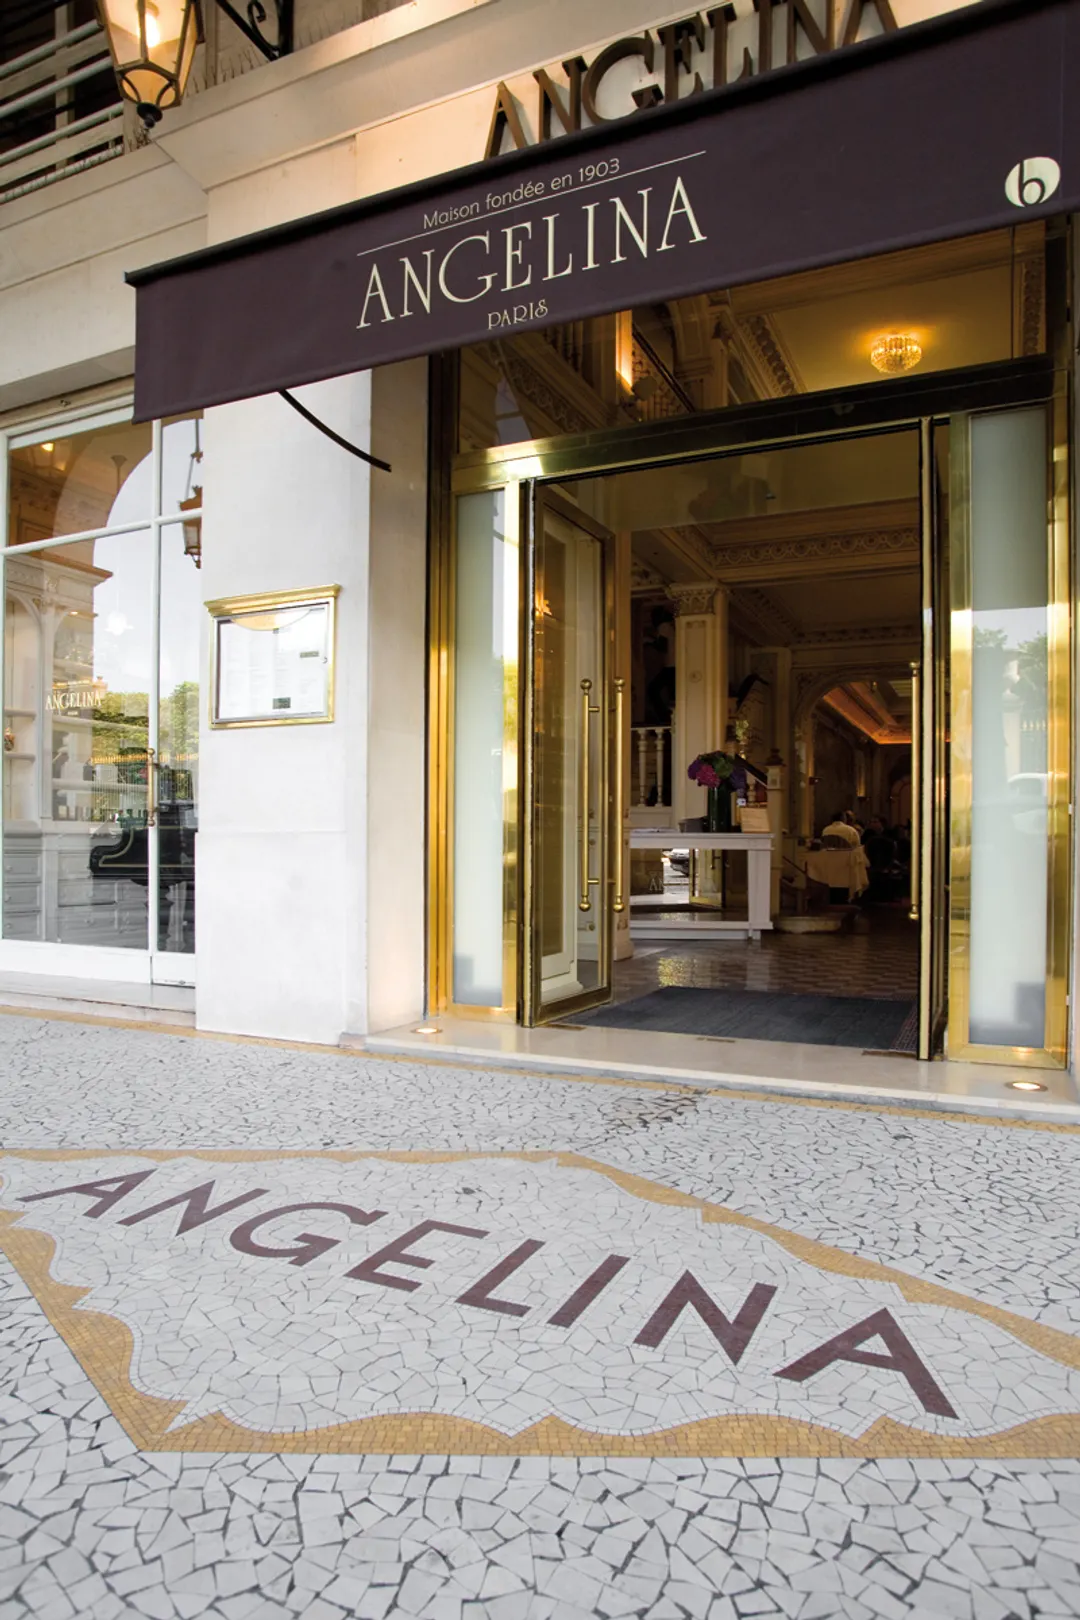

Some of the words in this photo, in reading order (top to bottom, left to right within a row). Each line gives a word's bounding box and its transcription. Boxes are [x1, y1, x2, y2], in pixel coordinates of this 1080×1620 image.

[484, 0, 899, 160] ANGELINA
[423, 200, 480, 230] Maison
[485, 180, 546, 210] fondée
[550, 174, 573, 191] en
[578, 157, 621, 182] 1903
[356, 176, 707, 329] ANGELINA
[487, 298, 549, 330] PARIS
[45, 689, 101, 710] ANGELINA
[15, 1168, 960, 1420] ANGELINA
